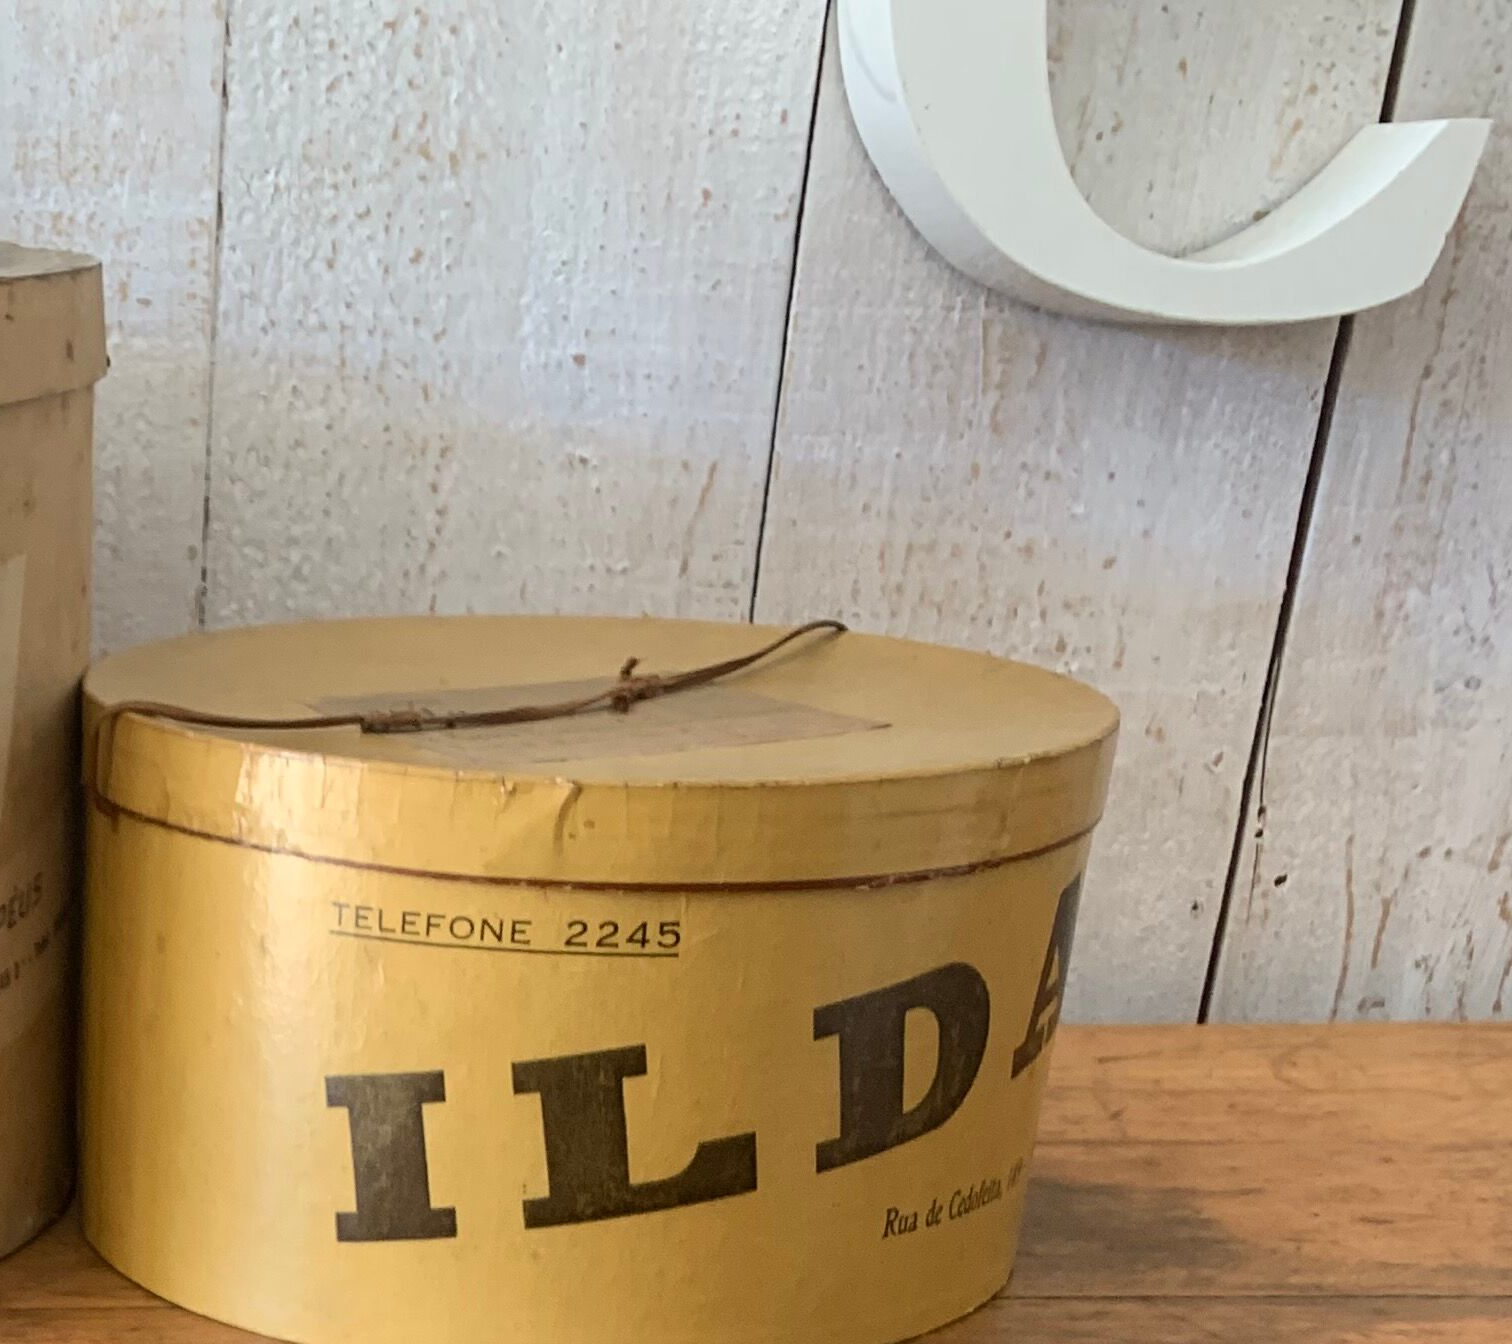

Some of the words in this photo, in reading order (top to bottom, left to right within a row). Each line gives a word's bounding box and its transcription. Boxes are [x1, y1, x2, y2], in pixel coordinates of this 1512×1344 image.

[331, 901, 533, 946] TELEFONE
[564, 920, 682, 950] 2245
[882, 1206, 918, 1240] Rua
[925, 1197, 944, 1227] de
